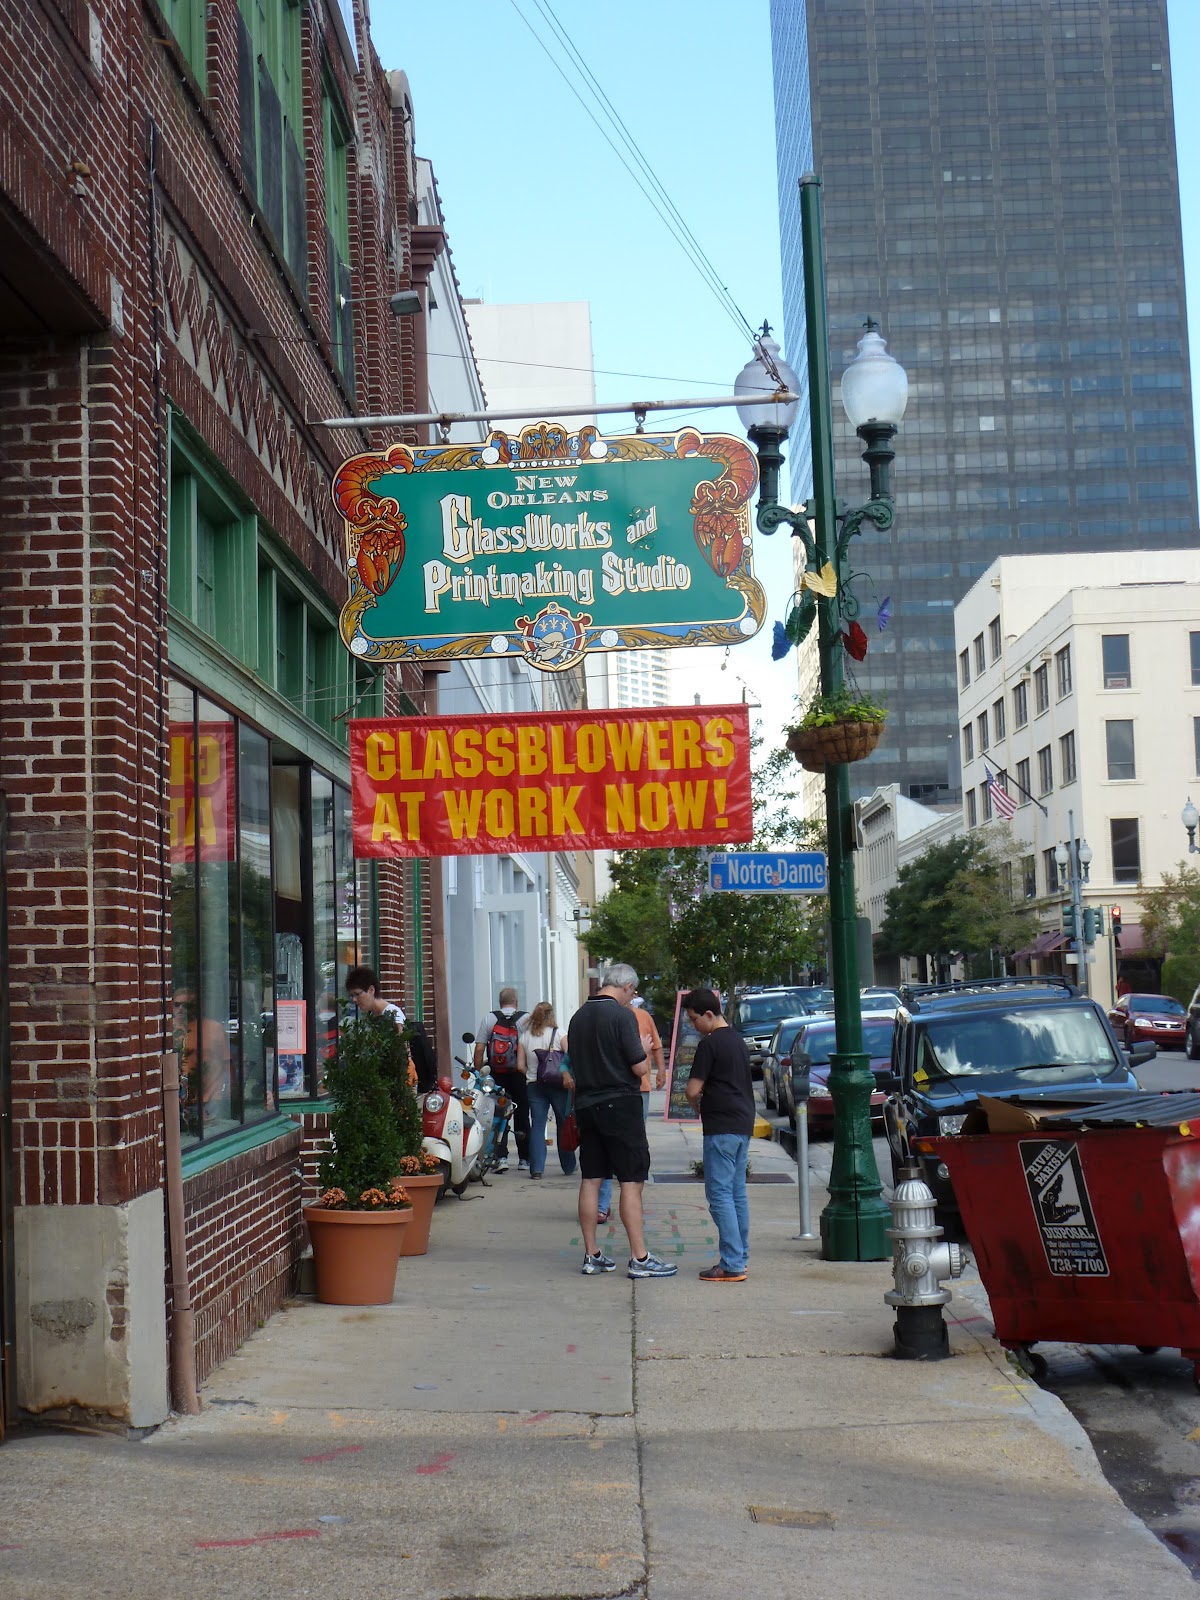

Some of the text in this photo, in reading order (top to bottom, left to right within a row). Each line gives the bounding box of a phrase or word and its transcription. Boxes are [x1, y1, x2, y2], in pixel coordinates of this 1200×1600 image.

[440, 493, 658, 564] GlassWorks and
[422, 551, 692, 613] Printmaking Studio
[365, 717, 736, 781] GLASSBLOWERS
[371, 779, 728, 841] AT WORK NOW!
[728, 858, 824, 885] Notre Dame
[1030, 1144, 1058, 1176] RIVER
[1034, 1150, 1067, 1187] PARISH
[1042, 1227, 1096, 1239] DISPOSAL
[1050, 1258, 1105, 1272] 738-7700
